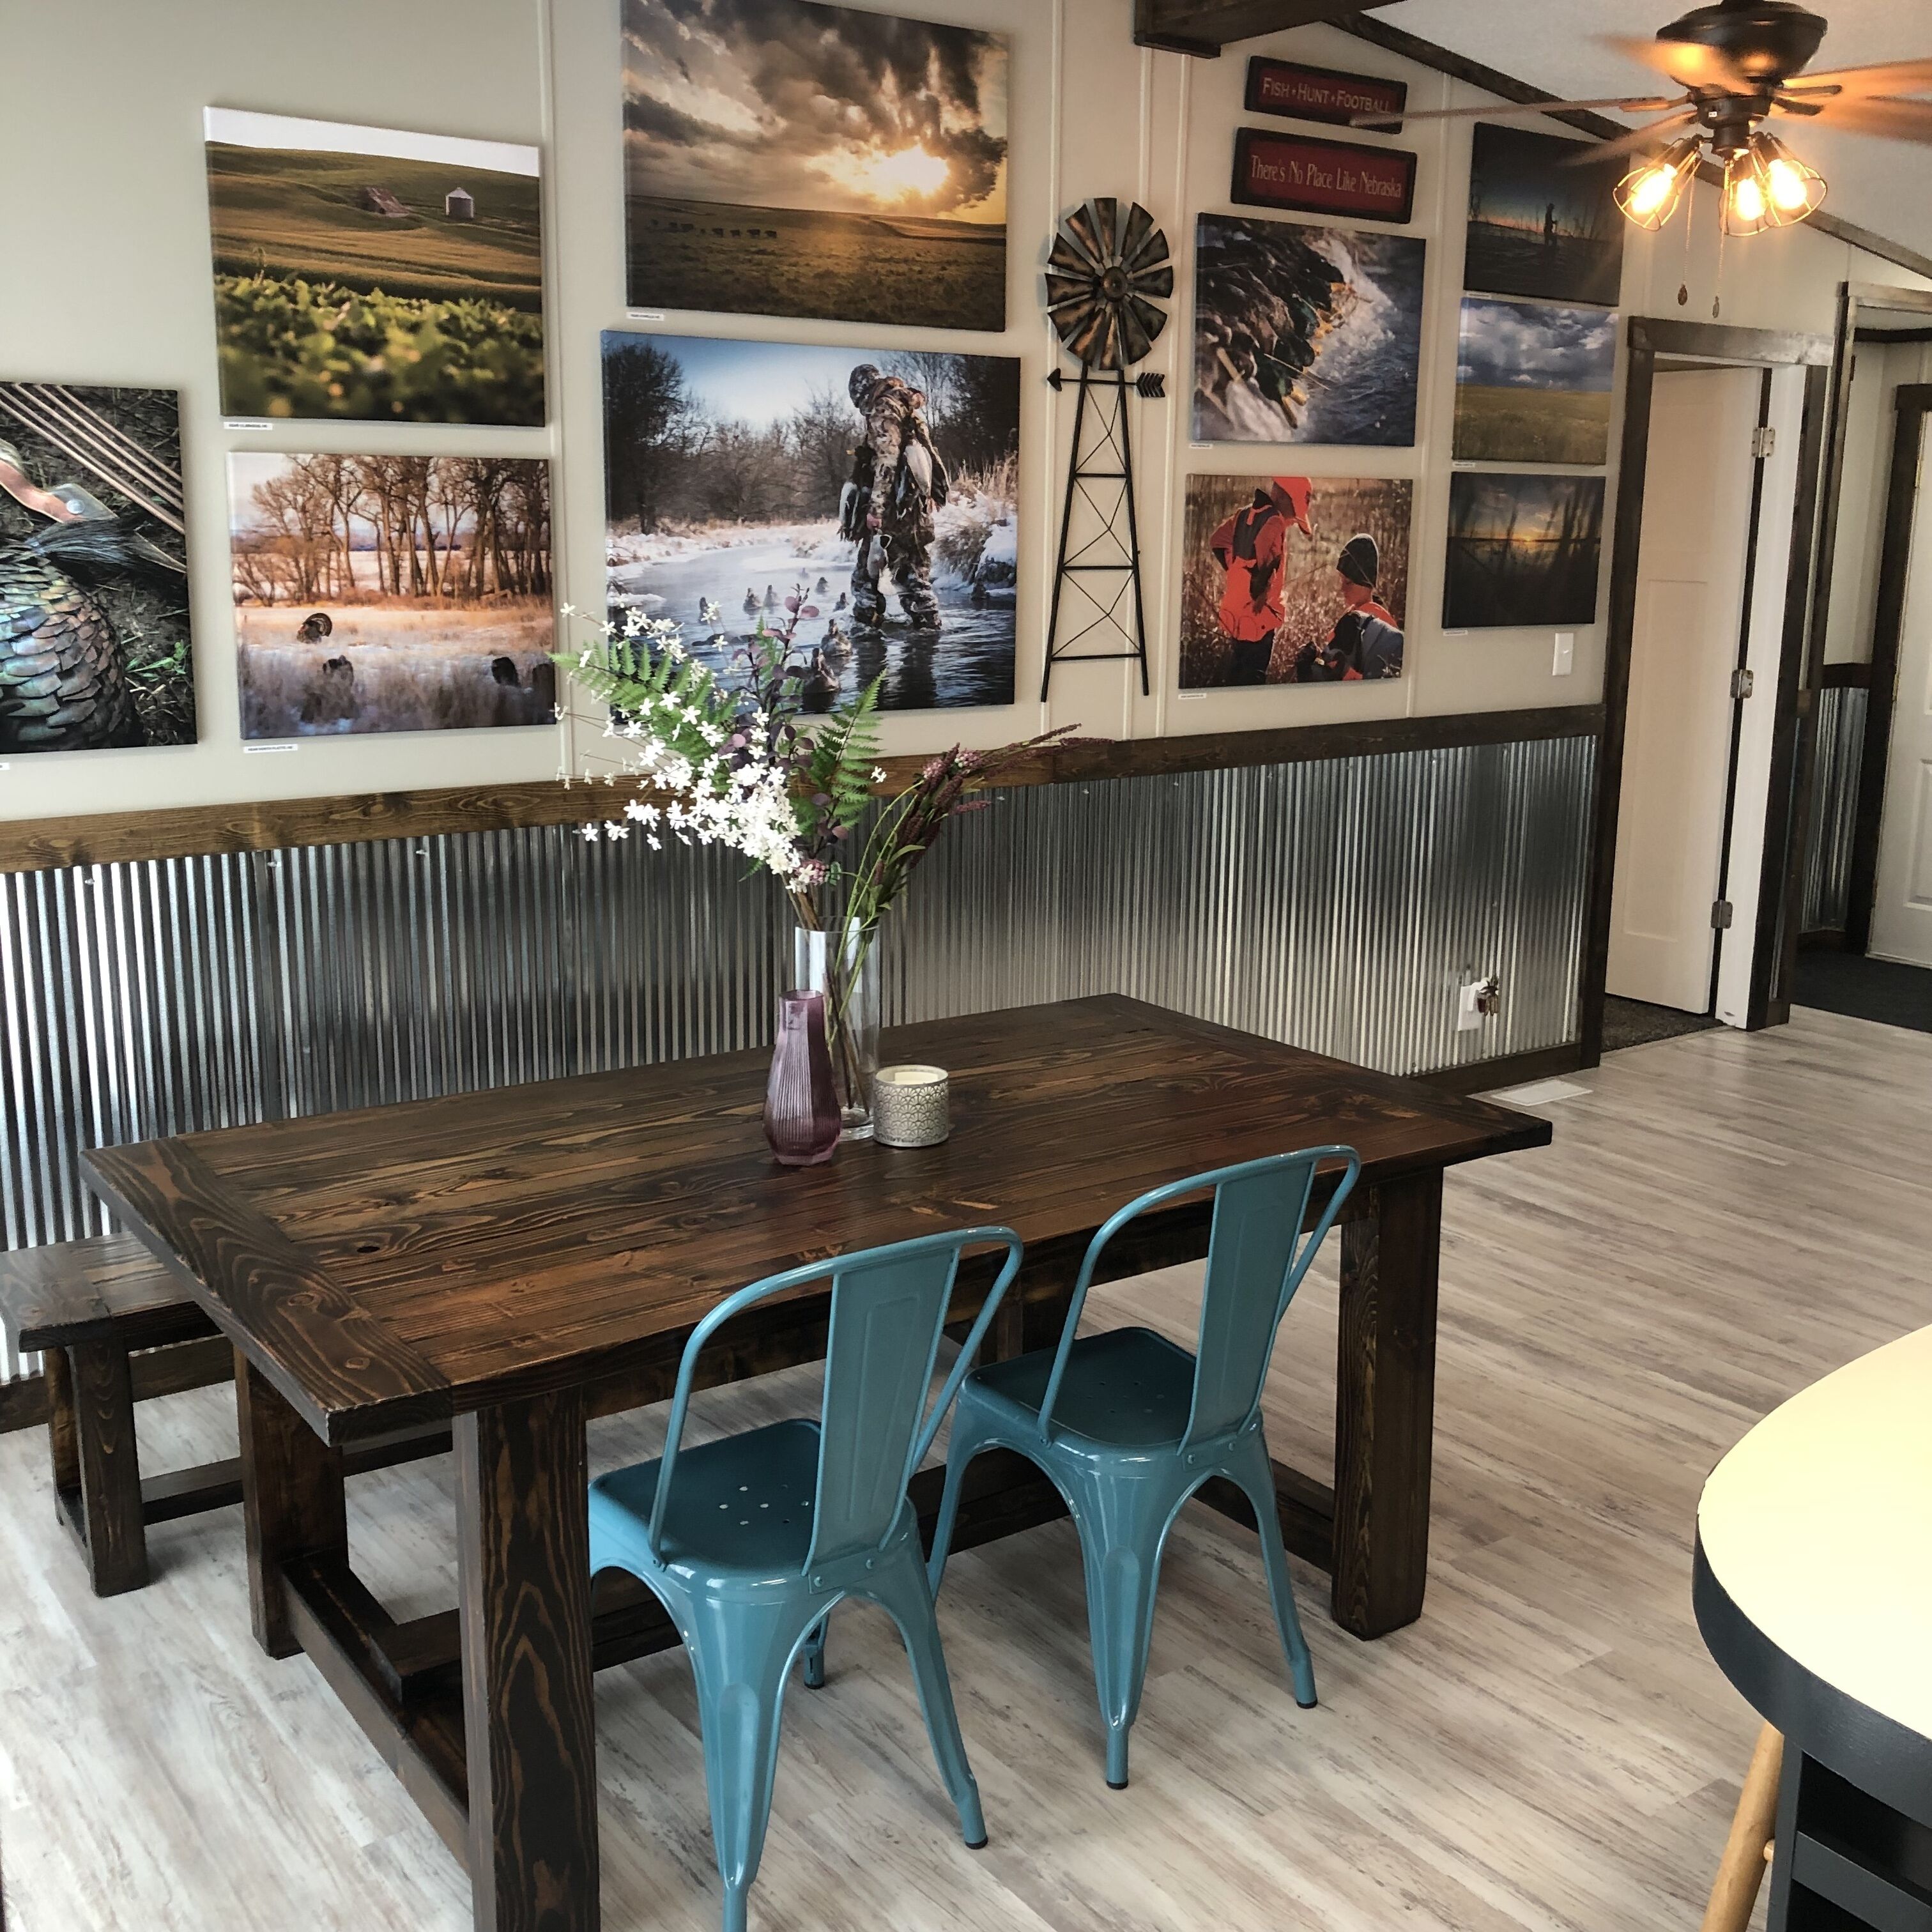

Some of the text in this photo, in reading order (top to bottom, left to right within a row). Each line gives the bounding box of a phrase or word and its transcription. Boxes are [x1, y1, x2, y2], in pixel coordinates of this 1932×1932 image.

[1262, 77, 1289, 96] FISH
[1297, 83, 1329, 103] HUNT
[1251, 155, 1402, 197] There's No Place Like Nebraska
